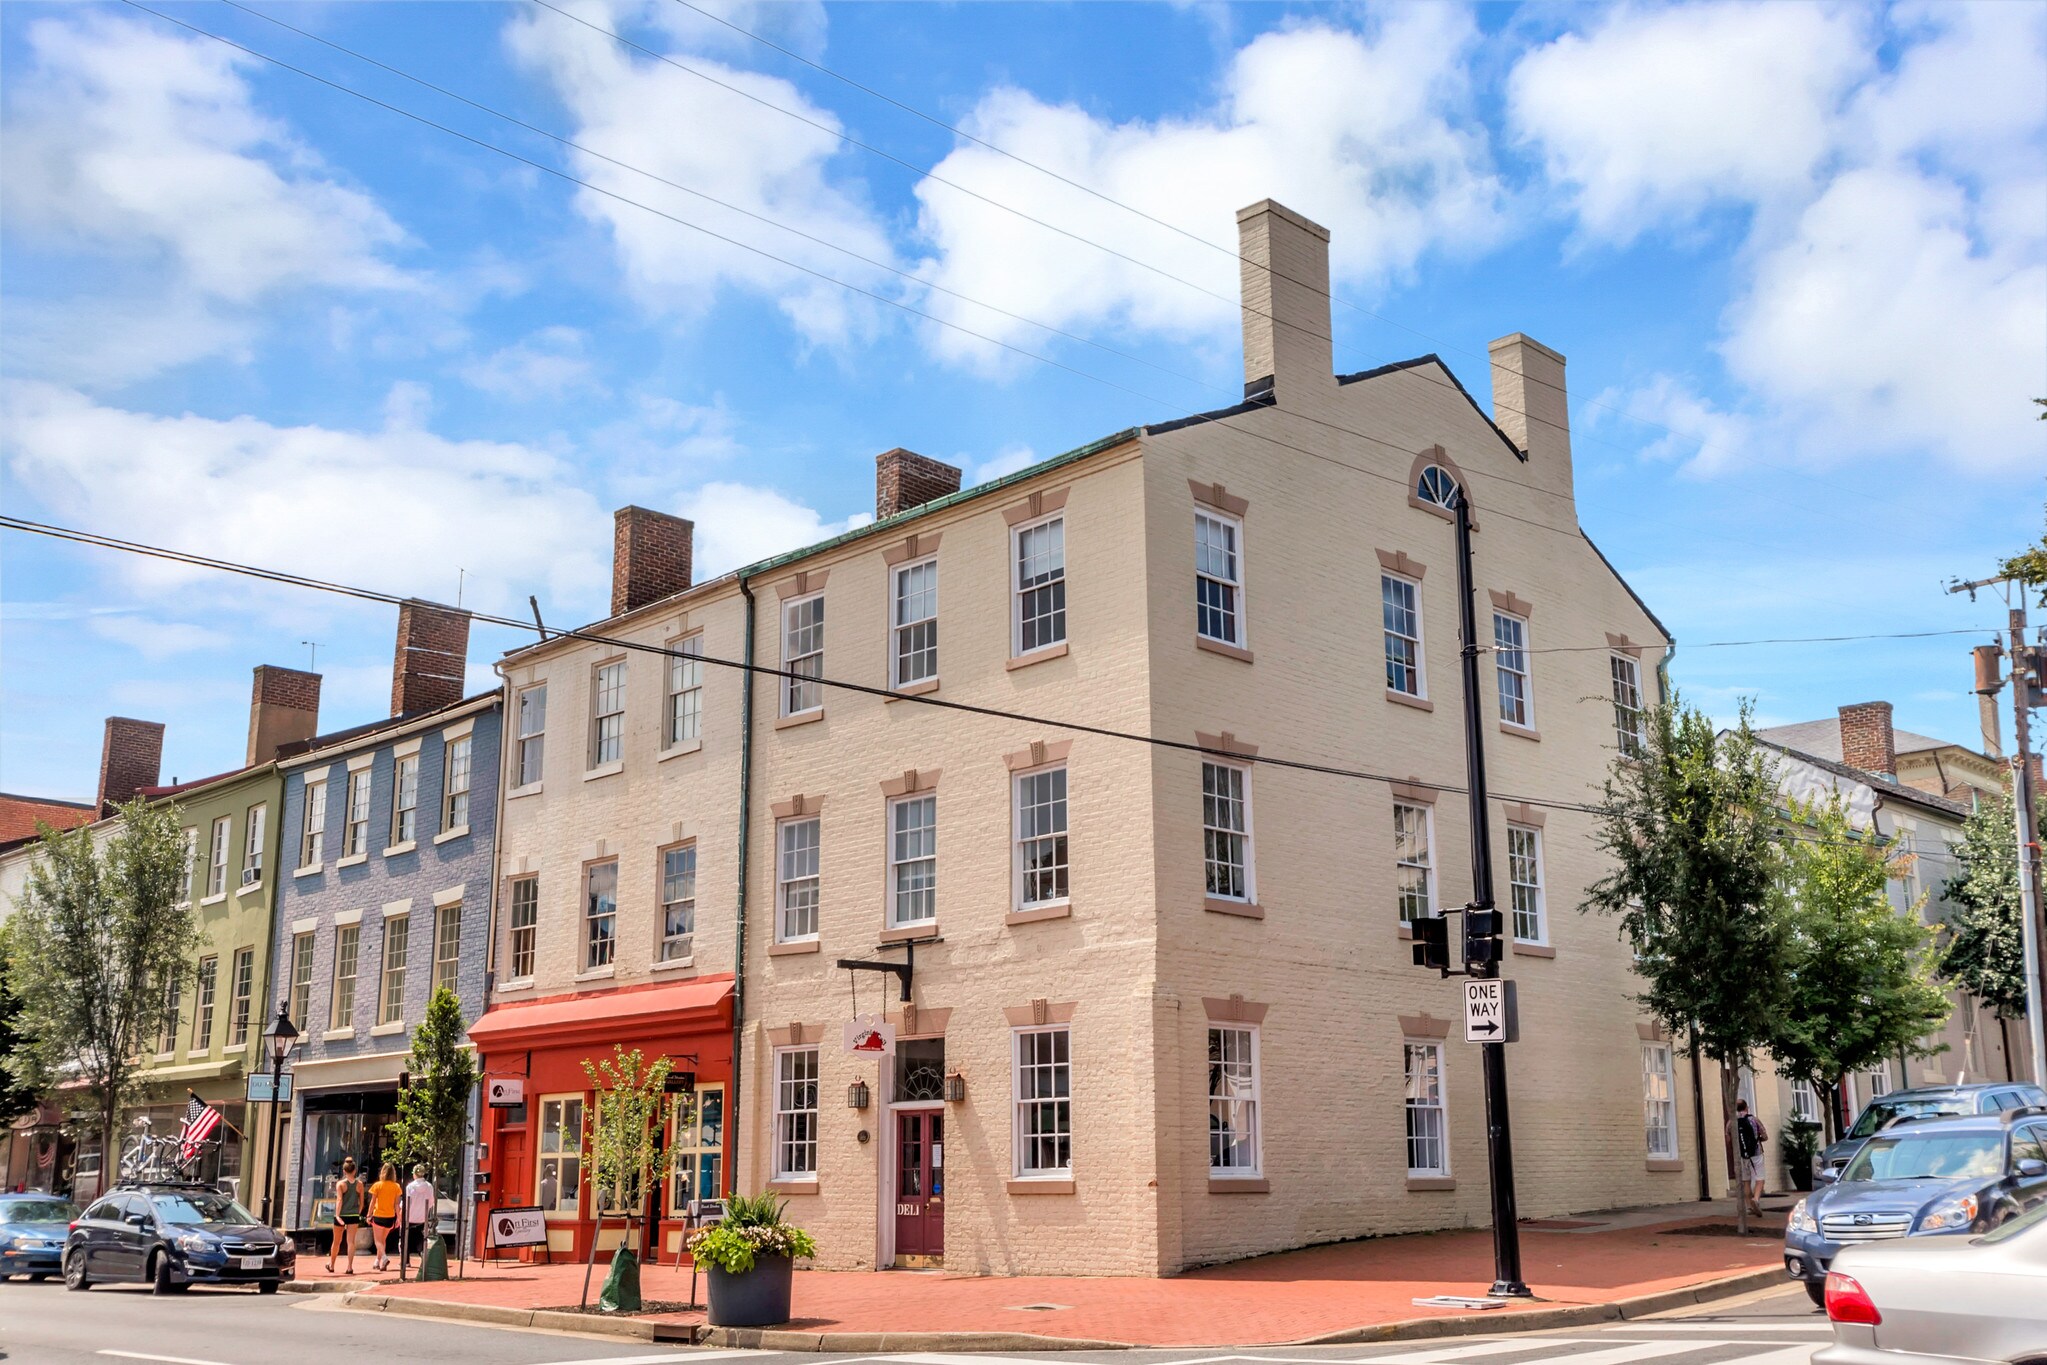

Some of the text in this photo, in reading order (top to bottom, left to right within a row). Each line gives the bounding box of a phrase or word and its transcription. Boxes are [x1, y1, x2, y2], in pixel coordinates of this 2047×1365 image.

[1469, 985, 1497, 999] ONE
[1470, 1002, 1499, 1017] WAY
[897, 1204, 920, 1216] DELI
[501, 1218, 539, 1236] Art First
